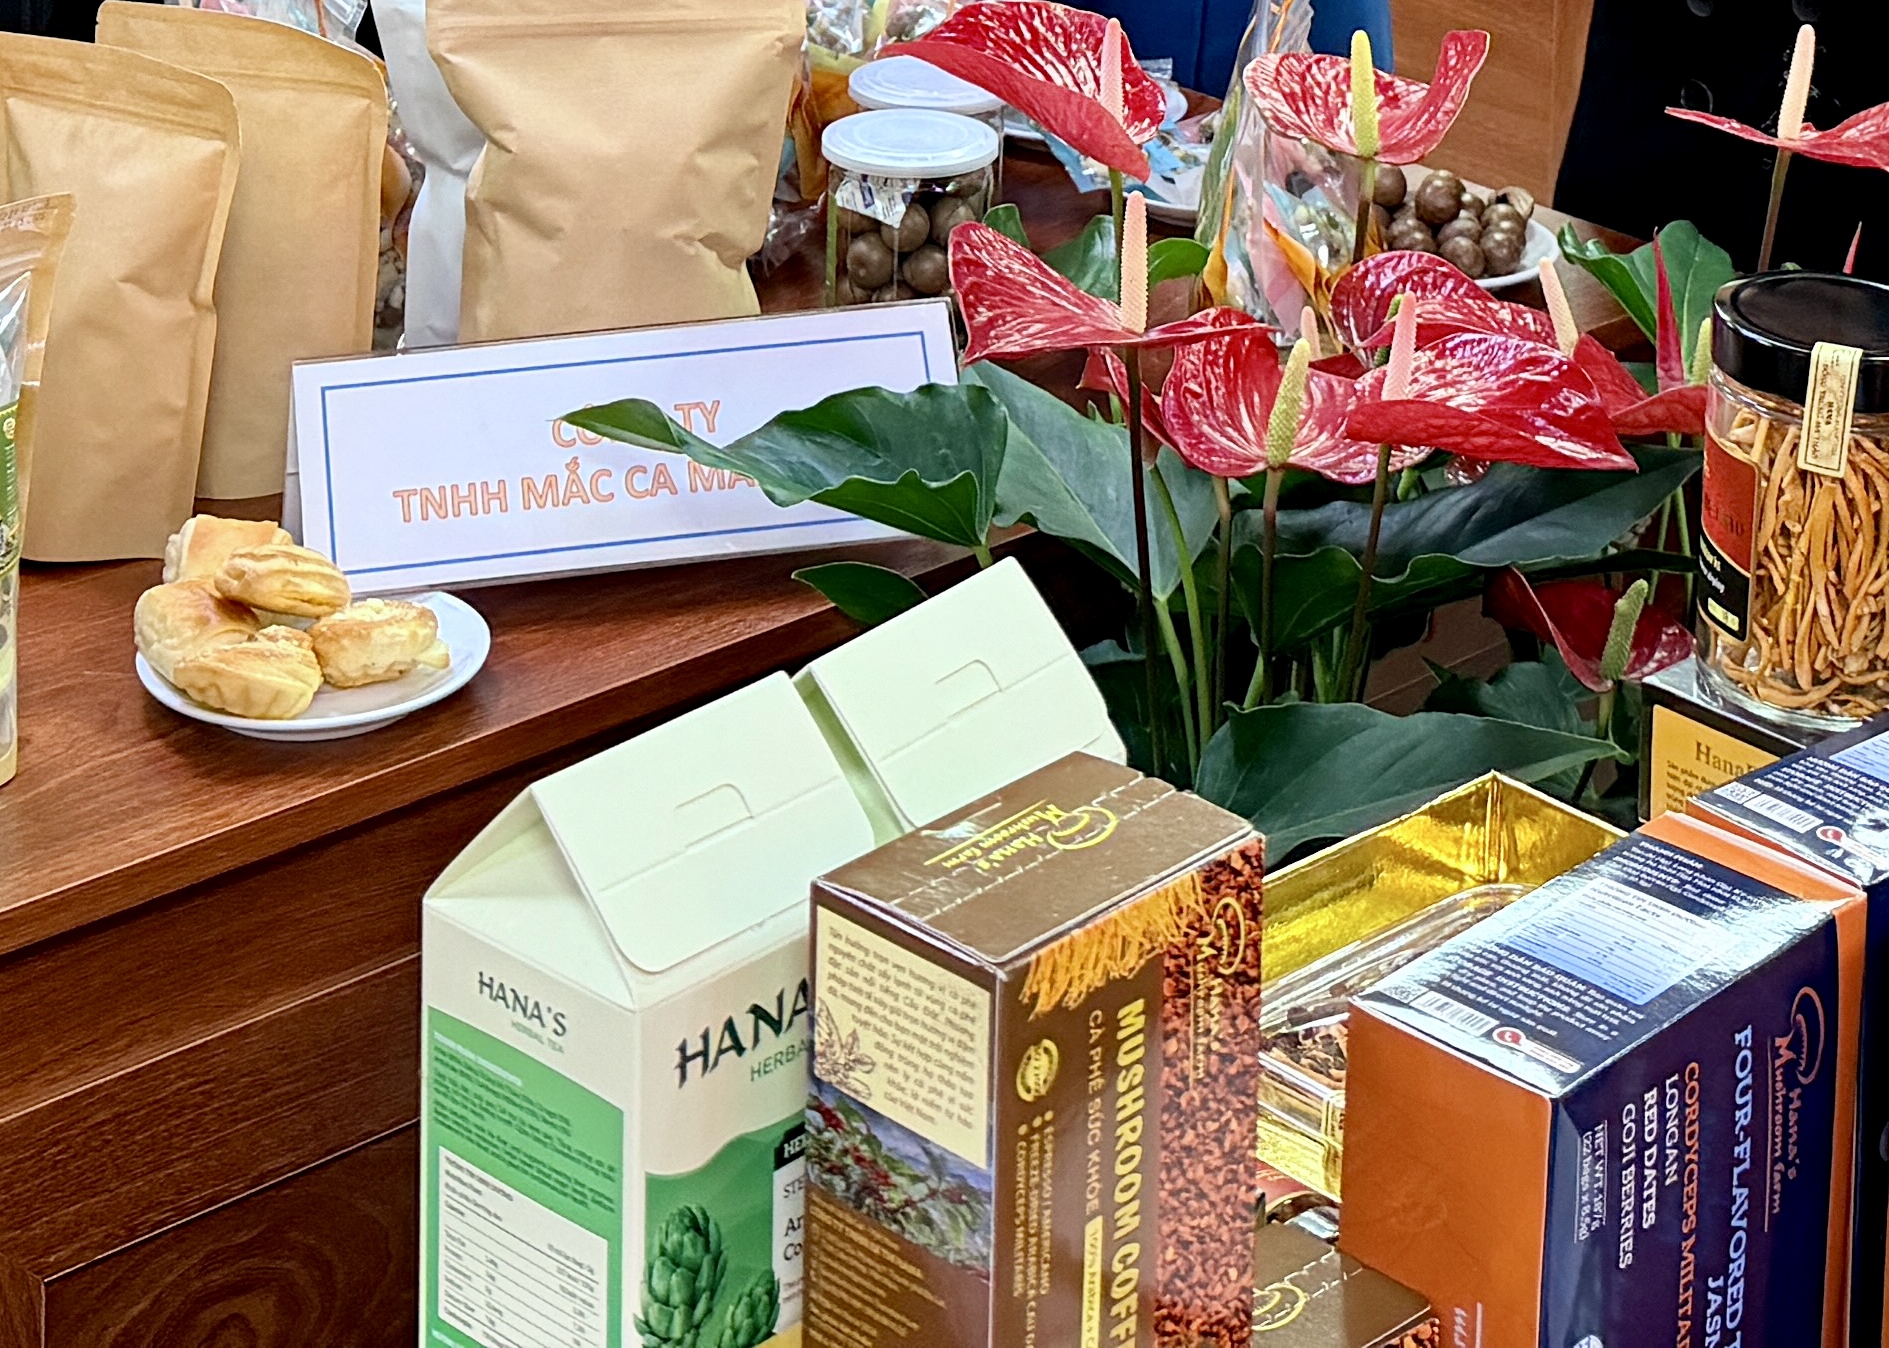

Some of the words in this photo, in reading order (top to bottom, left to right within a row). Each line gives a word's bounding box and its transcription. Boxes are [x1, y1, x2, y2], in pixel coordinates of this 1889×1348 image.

[674, 399, 722, 434] TY
[393, 478, 507, 525] TNHH
[520, 455, 615, 511] MẮC
[624, 461, 679, 499] CA
[941, 847, 982, 869] farm
[977, 832, 1044, 871] Hana's
[979, 804, 1063, 850] Mushroom
[478, 971, 569, 1038] HANA'S
[1195, 936, 1215, 1033] Mushroom
[1087, 1009, 1106, 1044] CÀ
[1194, 1037, 1209, 1079] farm
[1086, 1046, 1105, 1096] PHÊ
[1773, 1036, 1798, 1157] Mushroom
[1085, 1100, 1106, 1145] SỨC
[1111, 997, 1146, 1241] MUSHROOM
[1592, 1124, 1605, 1156] NET
[1621, 1103, 1636, 1162] GOJI
[1643, 1088, 1659, 1142] RED
[1664, 1074, 1679, 1186] LONGAN
[1681, 1061, 1700, 1233] CORDYCEPS
[1788, 1087, 1803, 1181] Hana's
[1014, 1141, 1029, 1224] CORDYCEPS
[1026, 1133, 1041, 1234] FREEZE-DRIED
[1040, 1125, 1055, 1198] ESPRESSO
[1579, 1157, 1593, 1191] bags
[1642, 1145, 1658, 1229] DATES
[1725, 1024, 1754, 1330] FOUR-FLAVORED
[1771, 1161, 1786, 1214] farm
[1039, 1206, 1054, 1295] AMERICANO
[1618, 1165, 1635, 1269] BERRIES
[1013, 1225, 1028, 1299] MILITARIS
[1024, 1236, 1039, 1299] ARABICA
[1109, 1242, 1142, 1348] COFF
